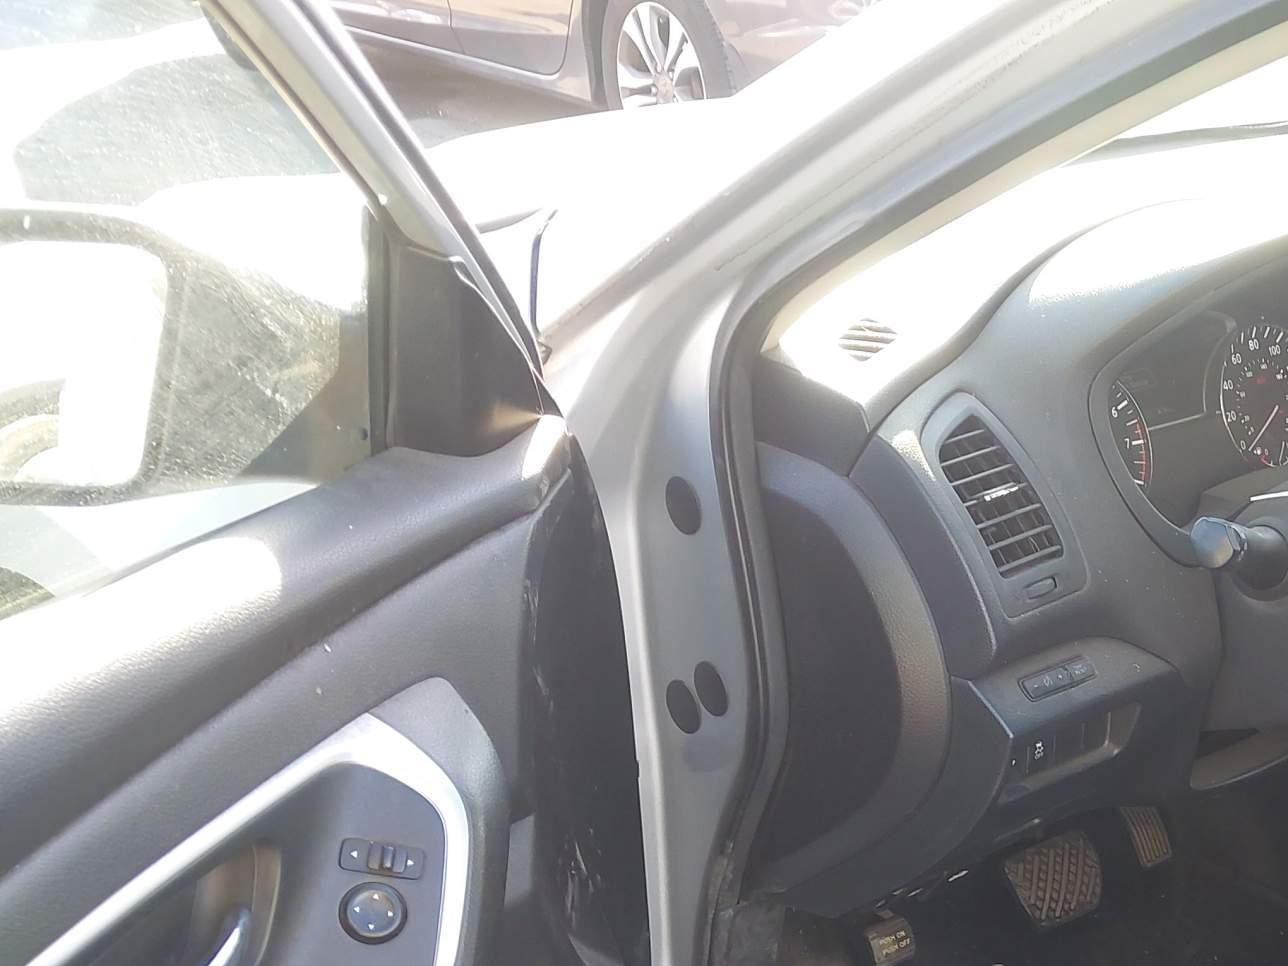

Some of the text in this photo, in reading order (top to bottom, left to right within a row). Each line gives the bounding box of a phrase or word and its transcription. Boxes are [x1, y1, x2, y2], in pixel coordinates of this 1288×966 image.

[1248, 339, 1259, 351] 80
[1268, 344, 1281, 357] 100
[1231, 353, 1242, 365] 60
[1223, 379, 1234, 390] 40
[1111, 406, 1118, 418] 6
[1226, 410, 1237, 422] 20
[1124, 438, 1130, 449] 7
[1240, 440, 1246, 450] 0
